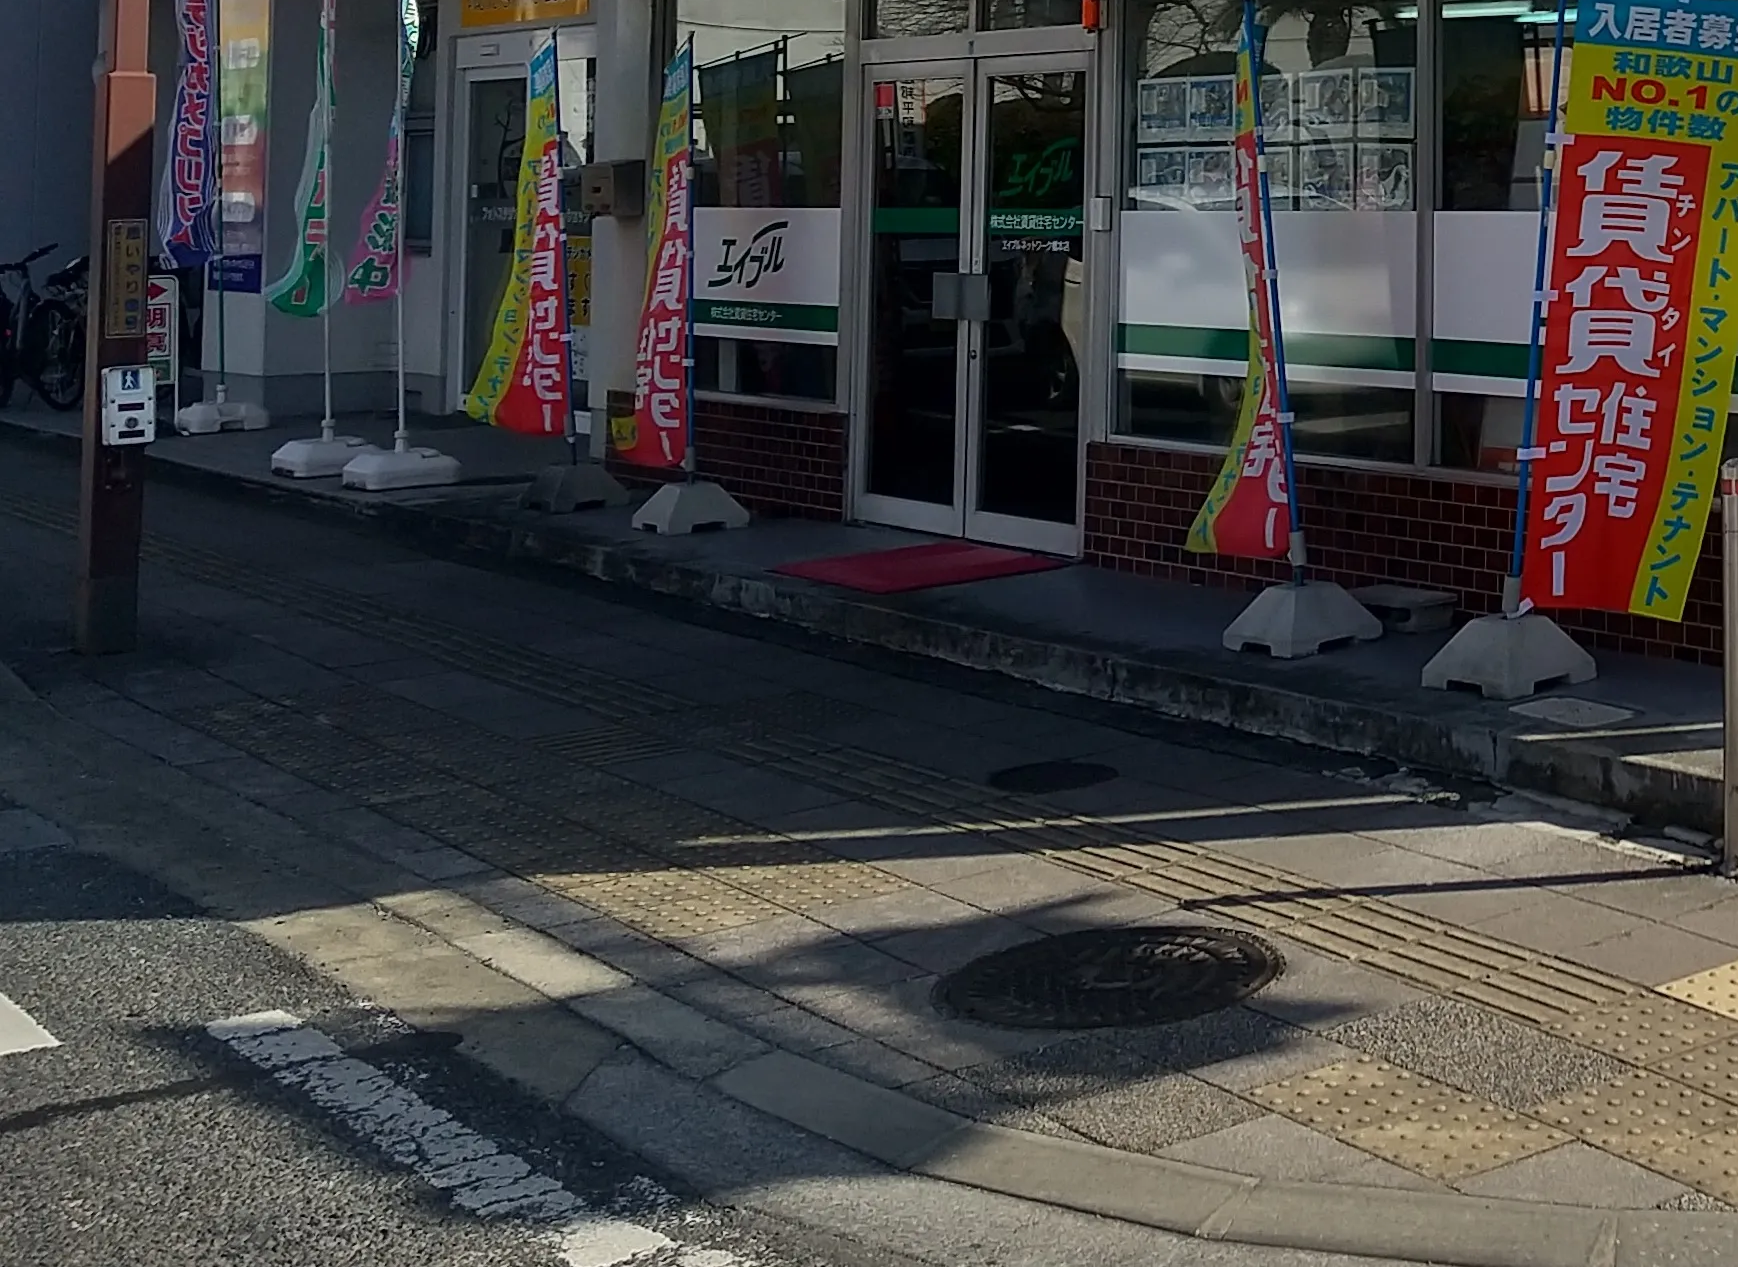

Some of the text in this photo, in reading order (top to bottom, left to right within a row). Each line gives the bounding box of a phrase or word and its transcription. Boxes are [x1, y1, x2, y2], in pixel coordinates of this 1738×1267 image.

[1612, 50, 1734, 85] 和歌山
[1605, 108, 1727, 142] 物件数
[1000, 137, 1080, 196] エイブル
[710, 223, 788, 288] エイブル
[1541, 383, 1602, 597] センター
